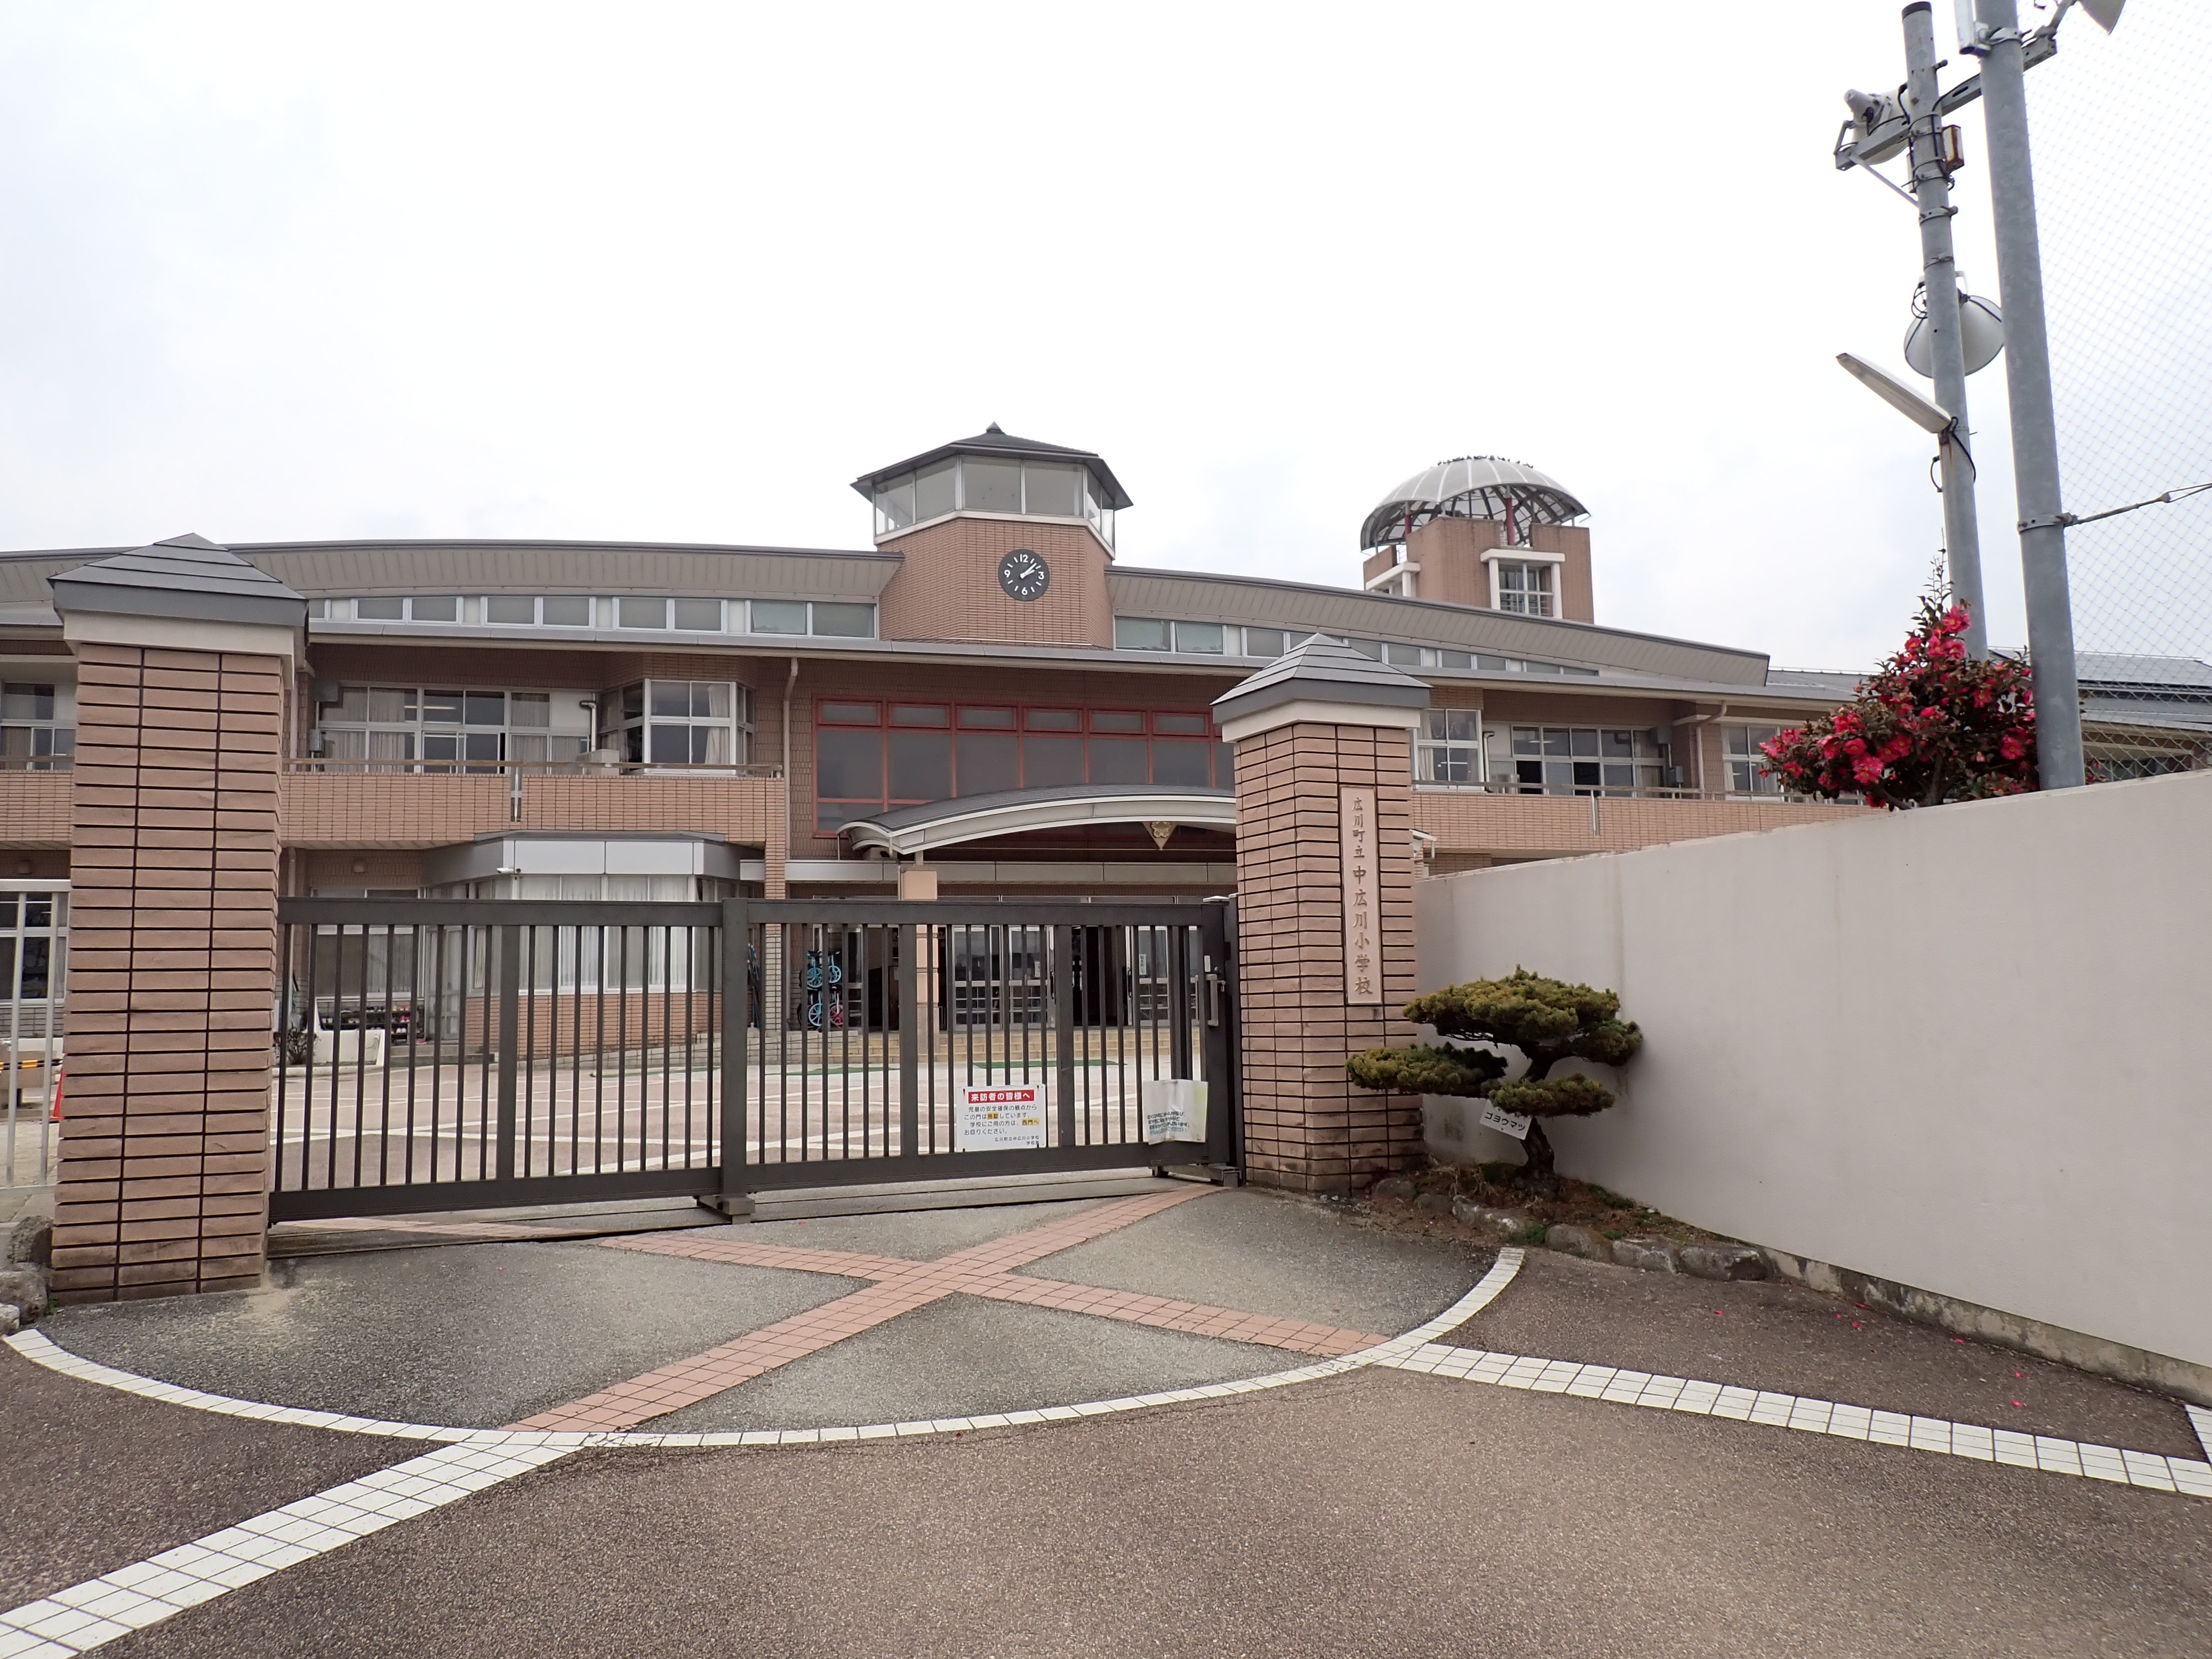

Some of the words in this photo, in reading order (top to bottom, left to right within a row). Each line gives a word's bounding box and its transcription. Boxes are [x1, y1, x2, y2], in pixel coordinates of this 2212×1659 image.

[1020, 554, 1028, 563] 12
[1004, 570, 1010, 578] 9
[1038, 571, 1045, 580] 3
[1021, 587, 1028, 596] 6
[1352, 797, 1373, 995] 広川町立中広川小学校
[971, 1092, 1030, 1102] 来訪者の皆様へ
